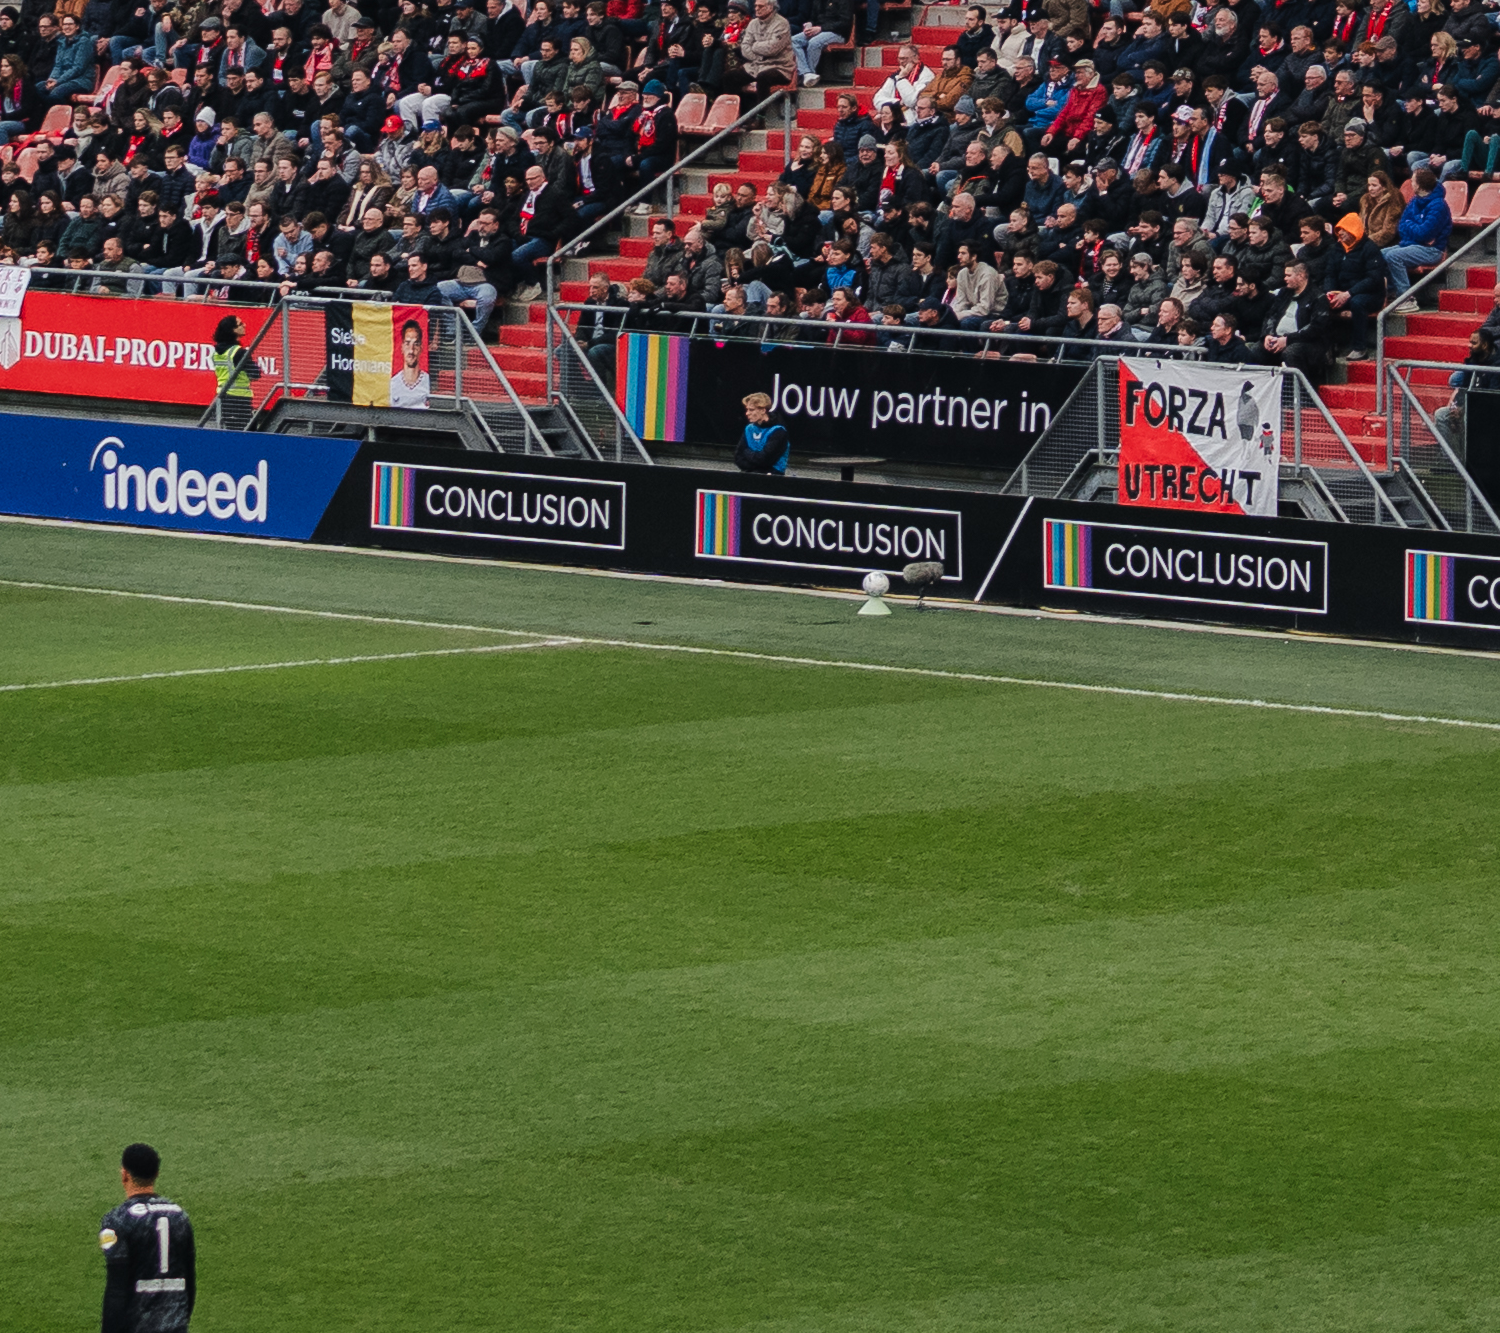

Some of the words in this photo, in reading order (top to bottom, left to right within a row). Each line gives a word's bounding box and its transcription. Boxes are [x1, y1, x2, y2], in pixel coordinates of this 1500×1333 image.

[768, 372, 862, 417] Jouw
[871, 381, 1010, 431] partner
[1019, 392, 1051, 434] in
[1123, 379, 1228, 440] FORZA
[102, 447, 268, 523] indeed
[425, 483, 611, 530] CONCLUSION
[1123, 462, 1263, 507] UTRECHT
[752, 511, 947, 561] CONCLUSION
[1104, 543, 1312, 594] CONCLUSION
[156, 1216, 170, 1273] 1
